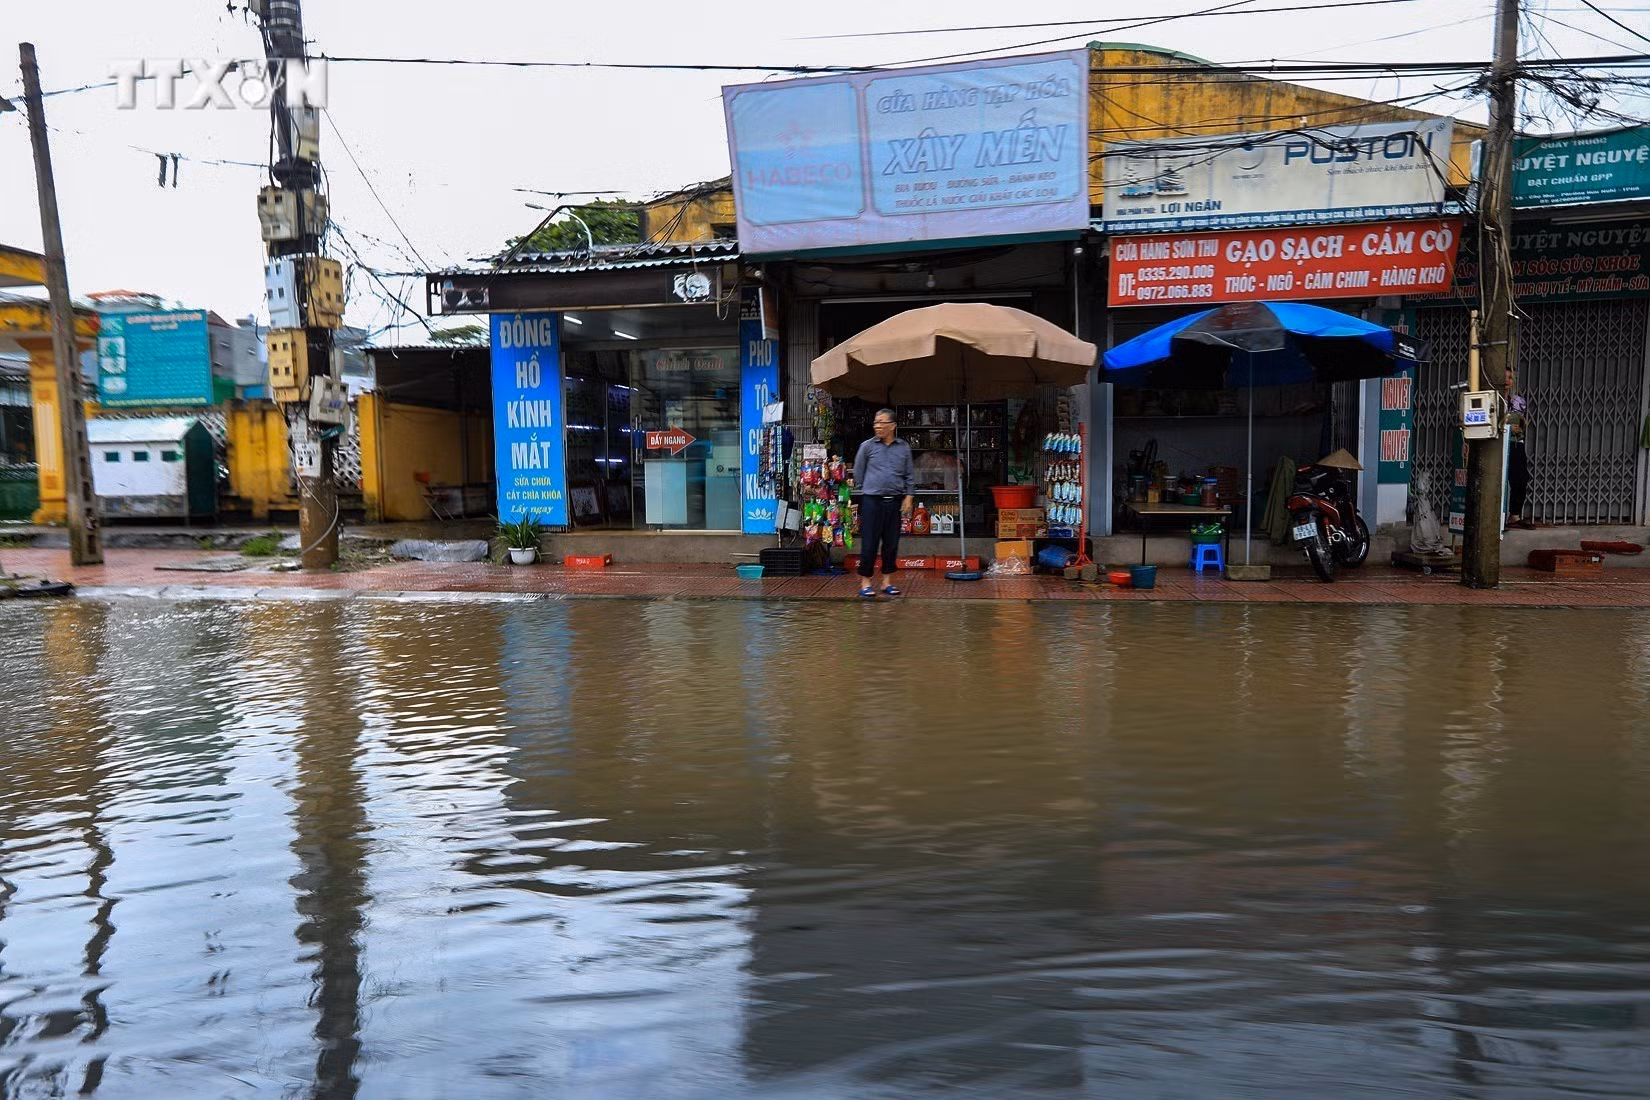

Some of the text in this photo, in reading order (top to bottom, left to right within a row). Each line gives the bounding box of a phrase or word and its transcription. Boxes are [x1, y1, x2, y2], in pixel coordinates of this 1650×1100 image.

[877, 88, 915, 114] CỬA
[922, 86, 979, 111] HÀNG
[882, 107, 1068, 176] XÂY MẾN
[746, 161, 852, 190] HABECO
[1512, 153, 1569, 172] UYỆT
[1590, 172, 1613, 182] GPP
[1115, 238, 1138, 262] CỬA
[1140, 238, 1171, 261] HÀNG
[1225, 239, 1276, 268] GẠO
[1280, 235, 1344, 266] SẠCH
[1419, 222, 1453, 253] CÒ
[1510, 230, 1562, 252] UYỆT
[1137, 264, 1215, 282] 0335.290.006
[1527, 257, 1558, 276] SÓC
[1560, 253, 1593, 275] SỨC
[1594, 250, 1641, 272] KHỎE
[1225, 272, 1256, 294] THÓC
[1267, 271, 1294, 292] NGÔ
[1336, 270, 1371, 289] CHIM
[1380, 265, 1417, 287] HÀNG
[1418, 262, 1446, 285] KHÔ
[1457, 282, 1478, 299] CHỨ
[1513, 277, 1572, 298] ỤNG CỤ Y TẾ
[1595, 274, 1622, 292] PHẨM
[1136, 283, 1213, 300] 0972.066.883
[515, 351, 541, 389] HỒ
[1381, 370, 1413, 418] NGUYỆT
[507, 395, 552, 429] KÍNH
[511, 432, 551, 470] MẮT
[664, 435, 686, 445] NGANG
[748, 428, 764, 456] CH
[1380, 422, 1411, 470] NGUYỆT
[530, 504, 554, 515] ngay
